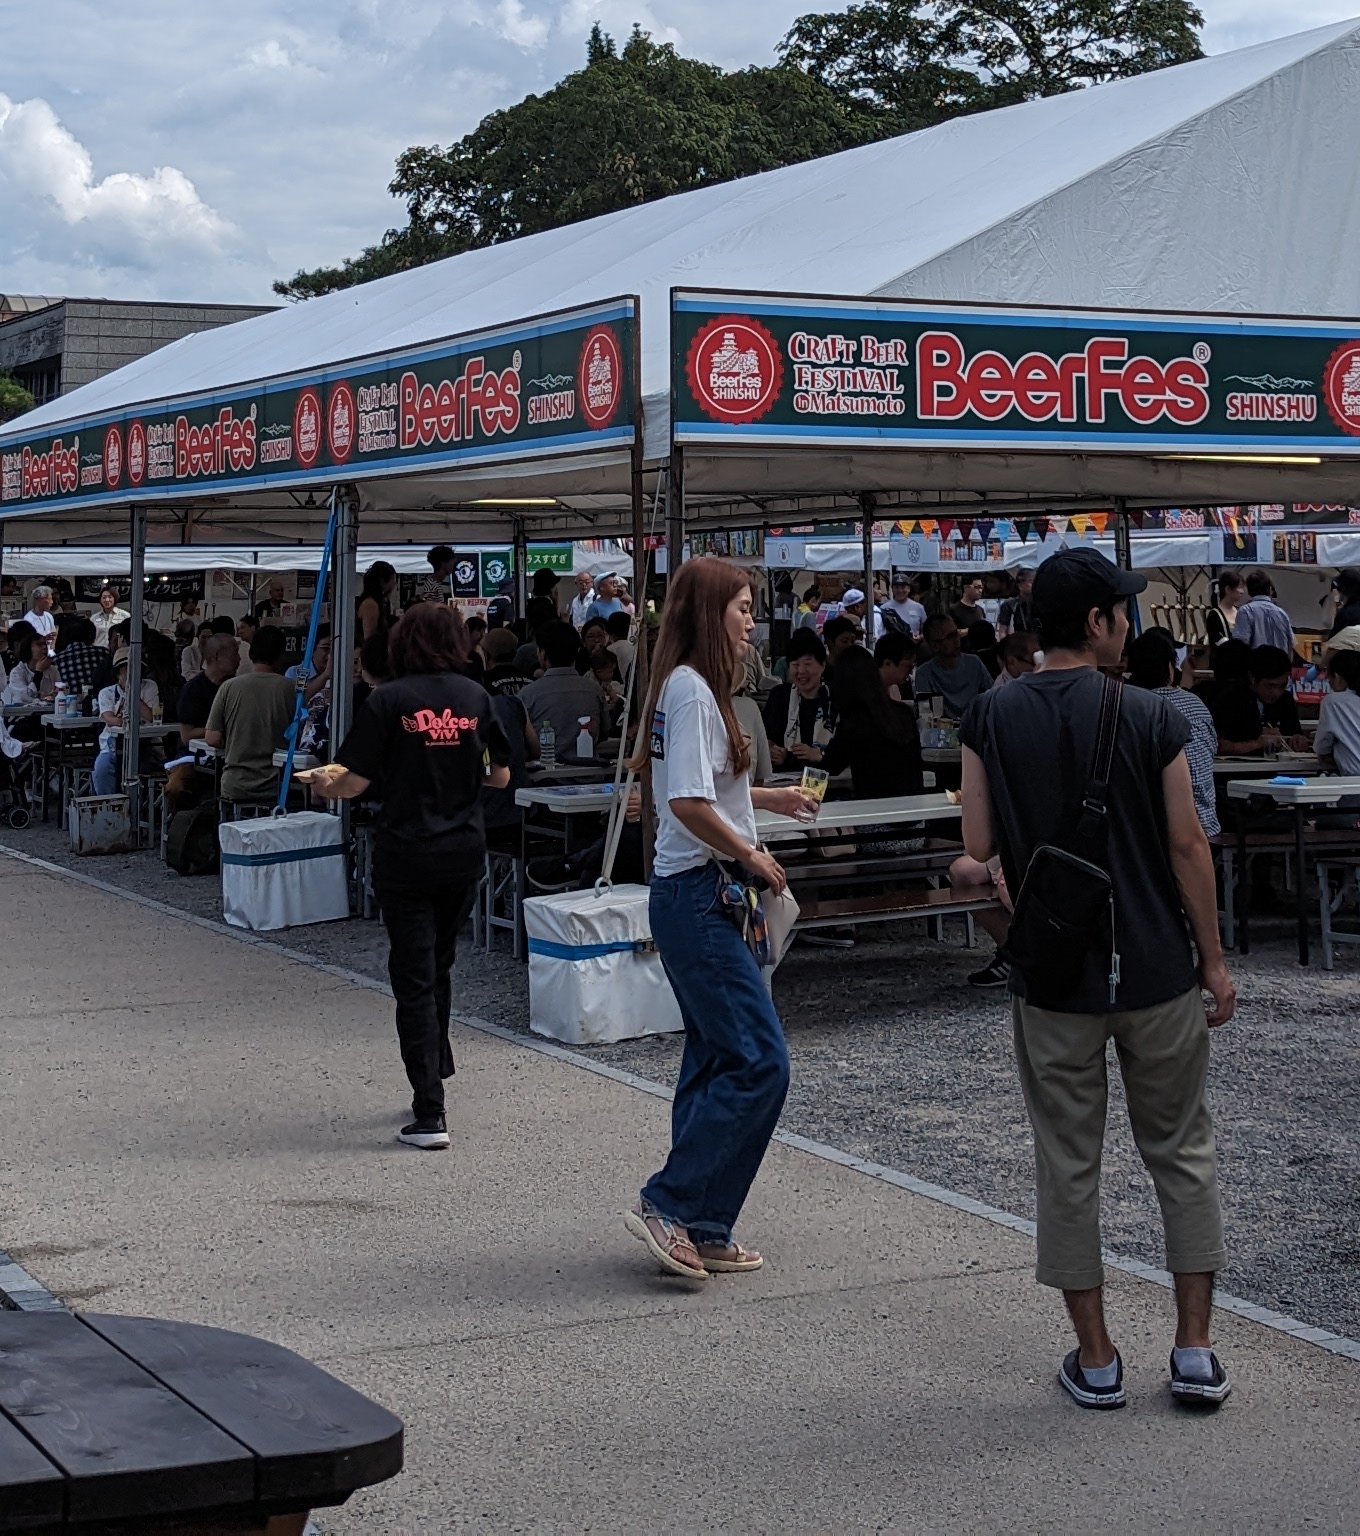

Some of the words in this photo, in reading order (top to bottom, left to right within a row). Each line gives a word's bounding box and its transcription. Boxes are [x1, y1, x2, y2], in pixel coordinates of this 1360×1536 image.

[788, 331, 857, 364] CRAFT
[860, 335, 909, 366] BEER
[710, 374, 762, 388] BeerFes
[793, 364, 905, 394] FESTIVAL
[527, 389, 575, 425] SHINSHU
[712, 388, 760, 400] SHINSHU
[1226, 393, 1317, 422] SHINSHU
[260, 436, 292, 463] SHINSHU
[526, 553, 568, 565] ラスすすぎ
[414, 708, 470, 732] Dolce
